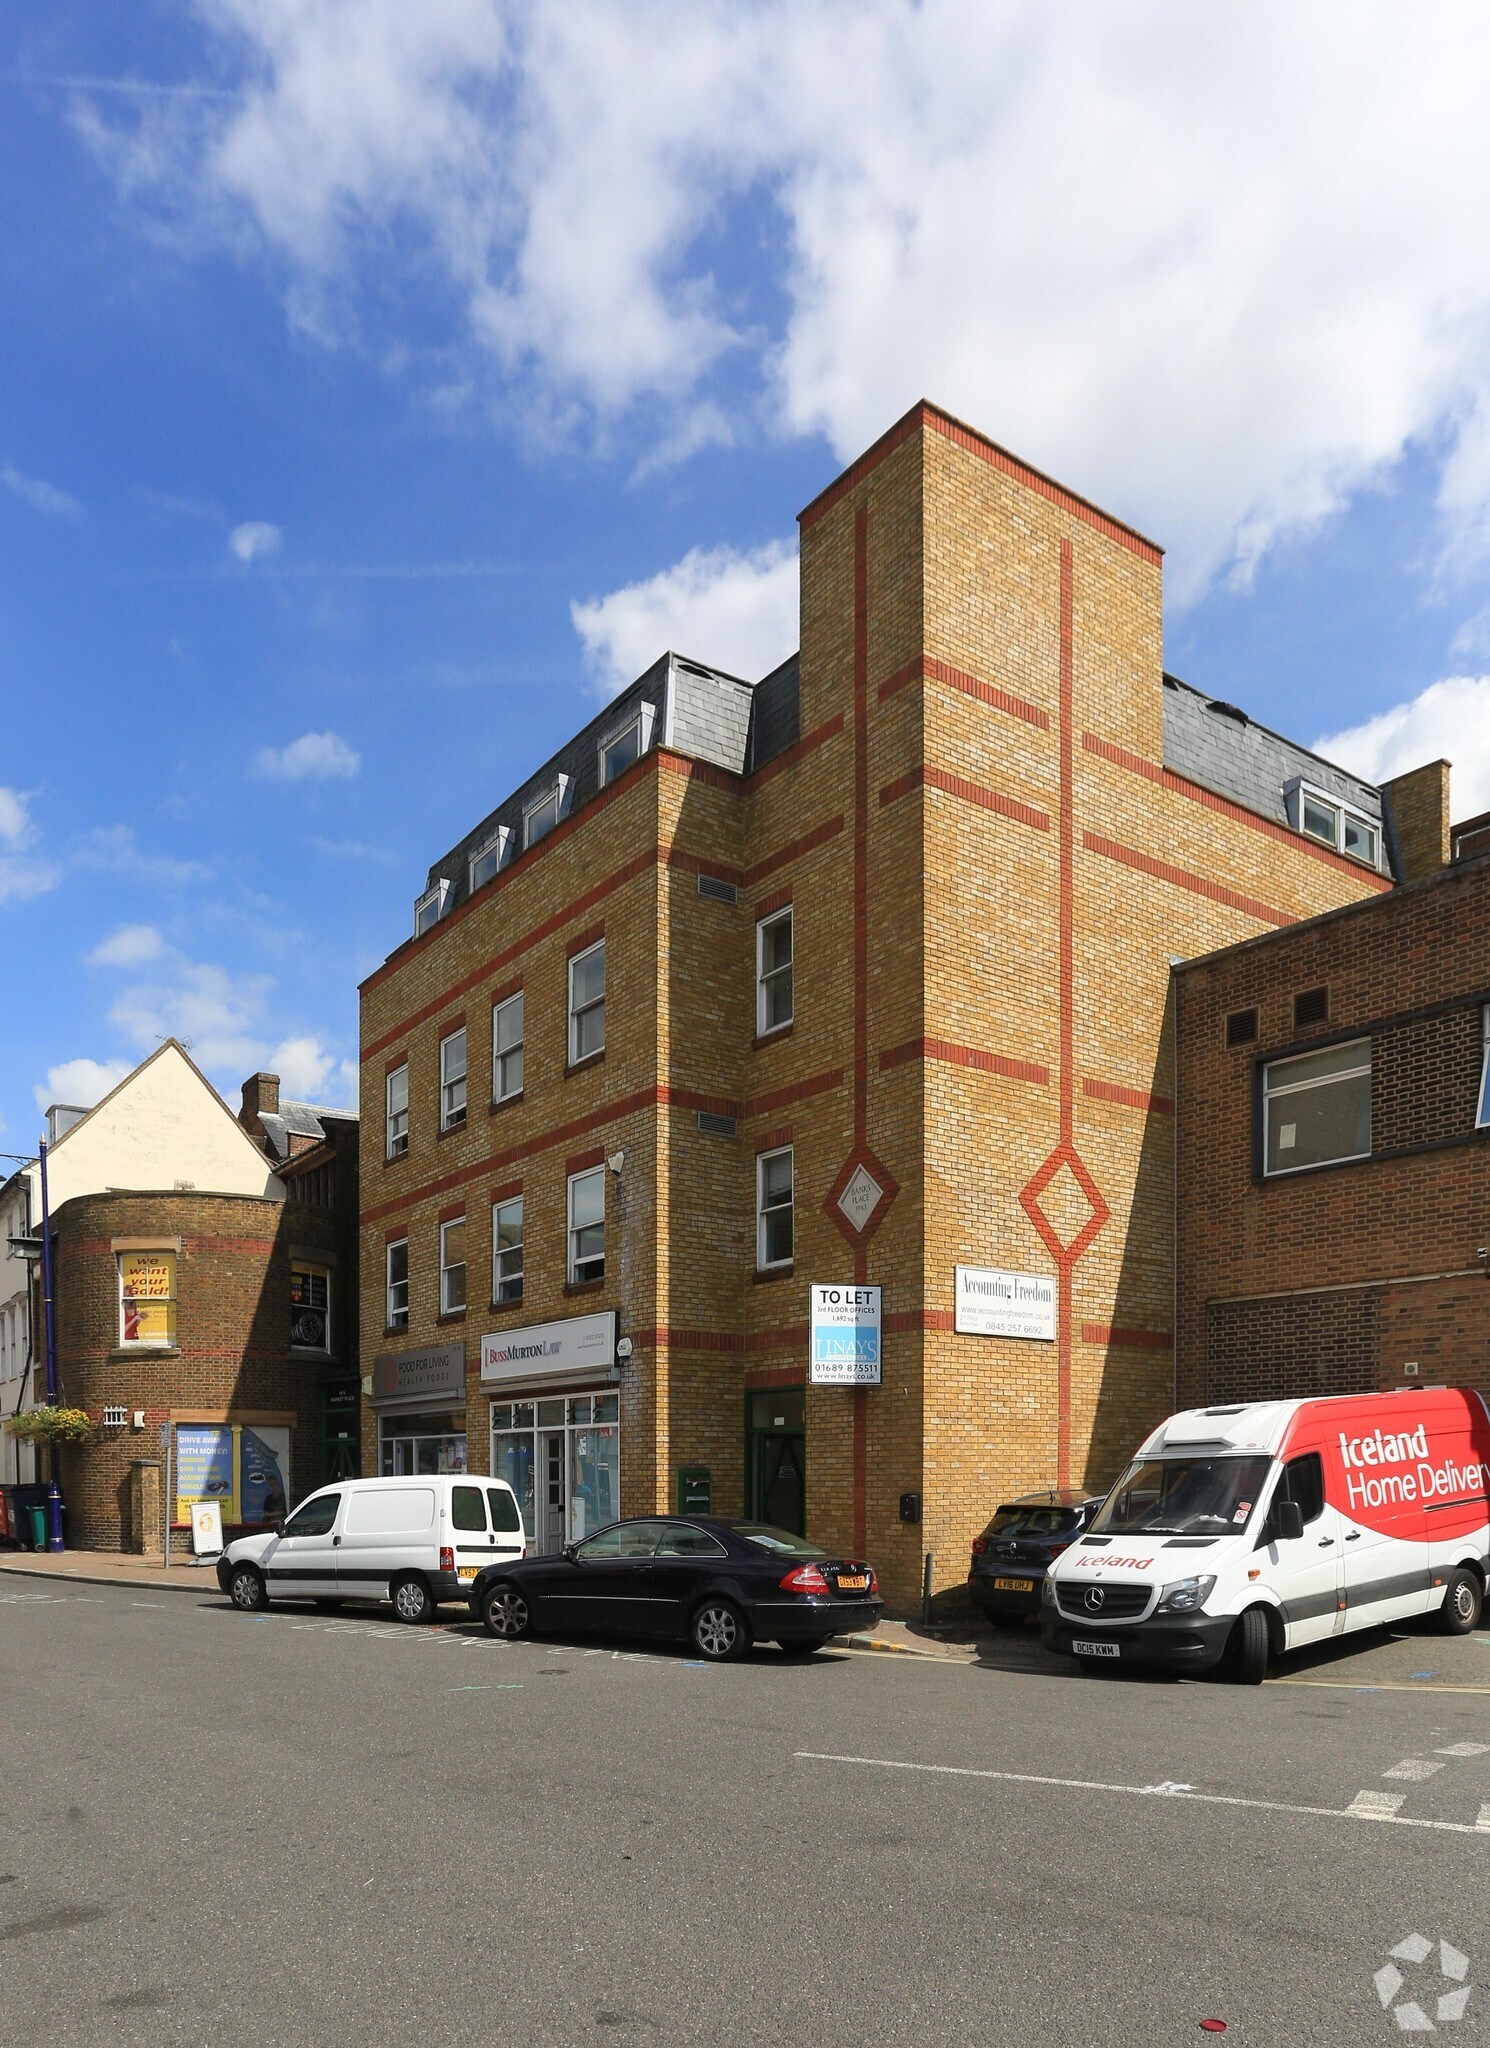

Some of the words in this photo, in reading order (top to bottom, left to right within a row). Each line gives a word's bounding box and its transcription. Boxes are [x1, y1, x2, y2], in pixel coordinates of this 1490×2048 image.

[851, 1184, 871, 1196] BANKS
[852, 1193, 870, 1204] PLACE
[129, 1267, 168, 1275] want
[131, 1278, 167, 1287] your
[961, 1271, 1013, 1305] Accounting
[1014, 1278, 1052, 1303] Freedom
[128, 1286, 170, 1295] Gold!
[819, 1290, 841, 1304] TO
[846, 1291, 873, 1305] LET
[985, 1322, 1006, 1331] 0845
[1007, 1323, 1022, 1333] 257
[1023, 1325, 1043, 1335] 6692
[816, 1339, 877, 1361] LINAYS
[399, 1361, 416, 1373] FOOD
[416, 1358, 429, 1371] FOR
[429, 1354, 449, 1369] LIVING
[814, 1363, 843, 1372] 01689
[847, 1364, 878, 1372] 875511
[427, 1372, 449, 1383] FOODS
[817, 1372, 875, 1381] www.linays.co.uk
[179, 1436, 201, 1444] DRIVE
[202, 1436, 221, 1444] AWAY
[1338, 1423, 1430, 1469] Iceland
[180, 1447, 199, 1455] WITH
[199, 1447, 228, 1455] MONEY!
[1346, 1471, 1417, 1511] Home
[1075, 1555, 1155, 1570] Iceland
[1076, 1642, 1094, 1654] DC15
[1095, 1644, 1114, 1656] KWM
